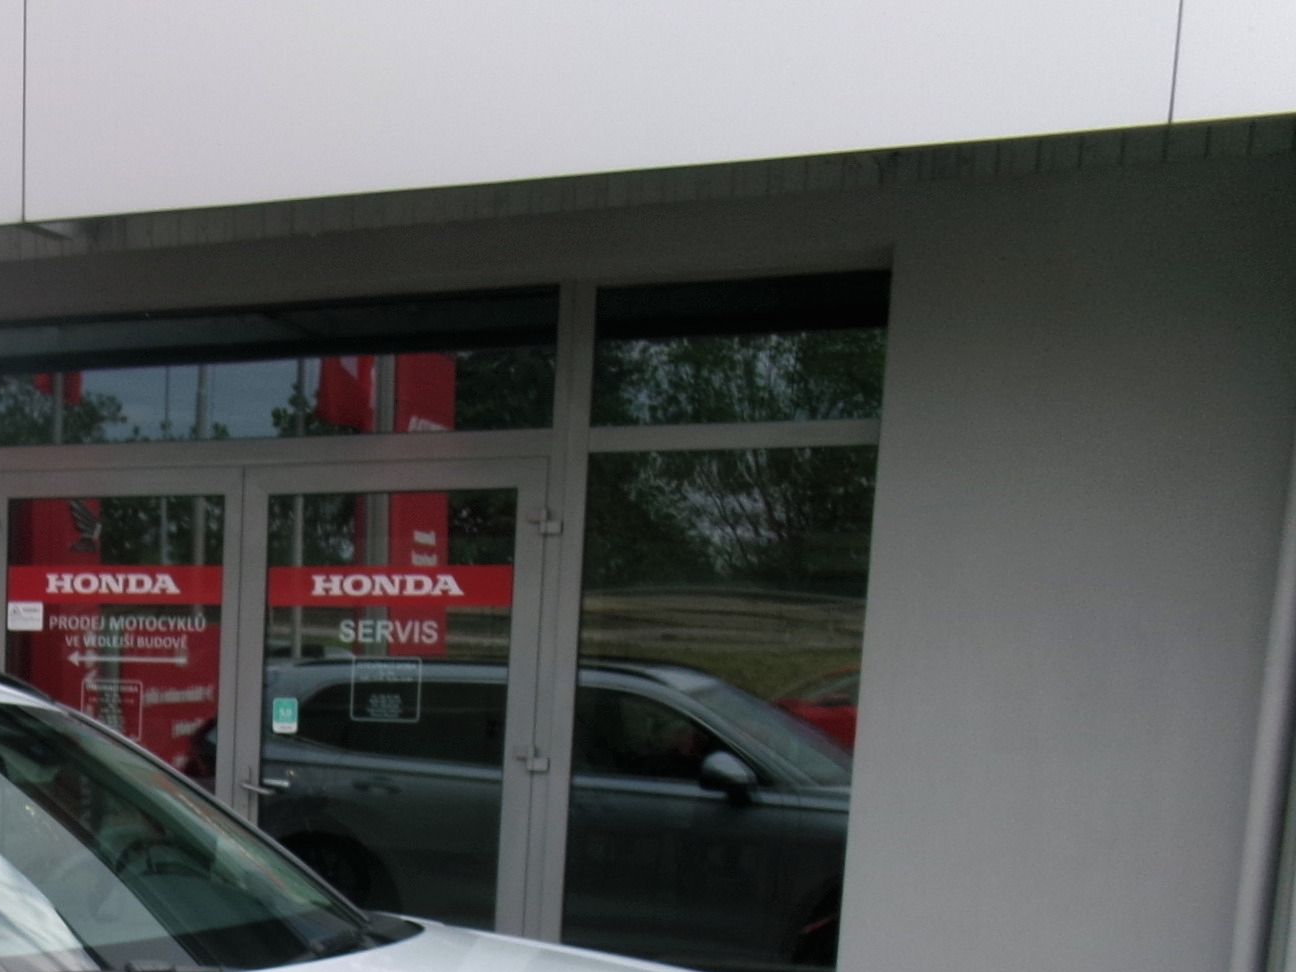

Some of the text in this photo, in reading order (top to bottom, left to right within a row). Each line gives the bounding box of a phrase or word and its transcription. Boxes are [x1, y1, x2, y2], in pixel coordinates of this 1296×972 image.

[46, 573, 180, 594] HONDA
[311, 574, 464, 596] HONDA
[49, 613, 206, 632] PRODEJ MOTOCYKLŮ
[339, 619, 439, 643] SERVIS
[65, 635, 79, 647] VE
[83, 633, 134, 648] VEDLEJŠÍ
